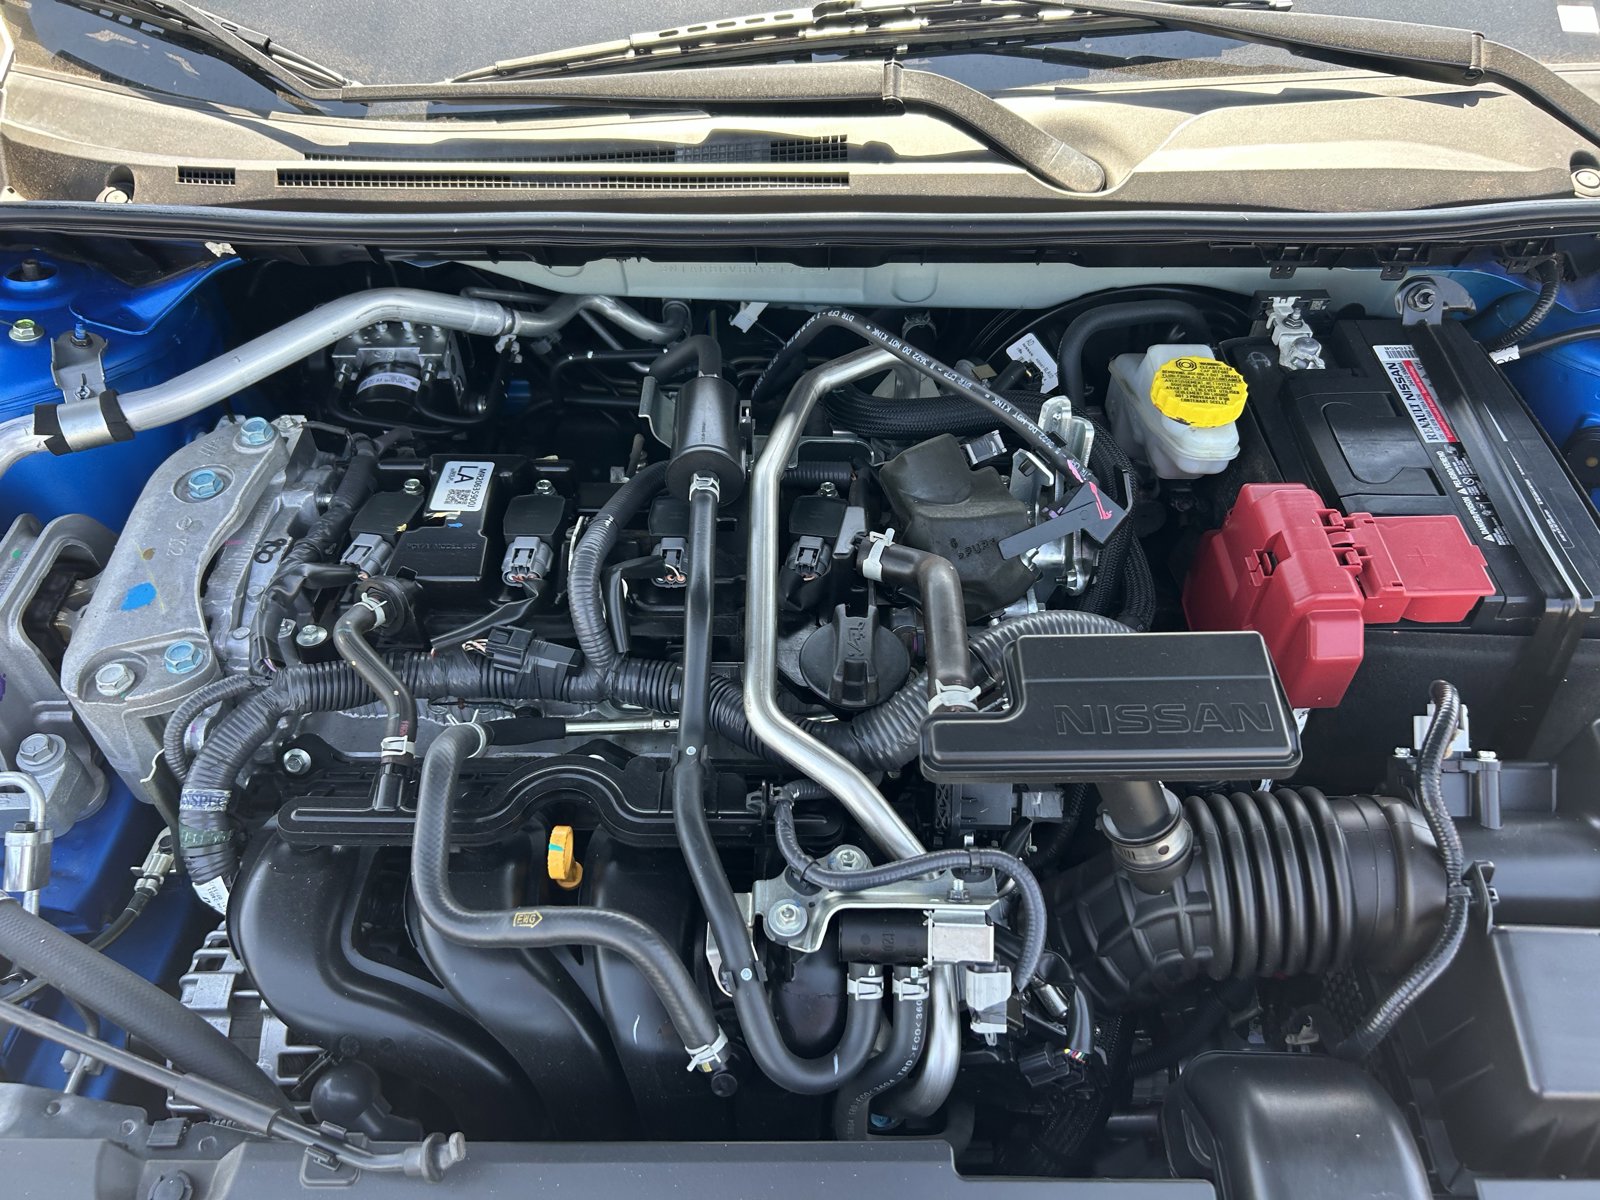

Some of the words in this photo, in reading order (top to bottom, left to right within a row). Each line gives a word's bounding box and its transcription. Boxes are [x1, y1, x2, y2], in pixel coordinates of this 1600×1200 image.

[841, 312, 855, 322] DTR
[871, 328, 888, 342] KINK
[888, 337, 901, 349] NOT
[902, 345, 912, 355] DO
[912, 350, 929, 365] 3622
[1385, 362, 1416, 400] NISSAN
[991, 397, 1012, 413] KINK
[1408, 404, 1439, 440] RENAULT
[454, 465, 478, 484] LA
[1055, 703, 1274, 735] NISSAN
[897, 1059, 913, 1078] TRD
